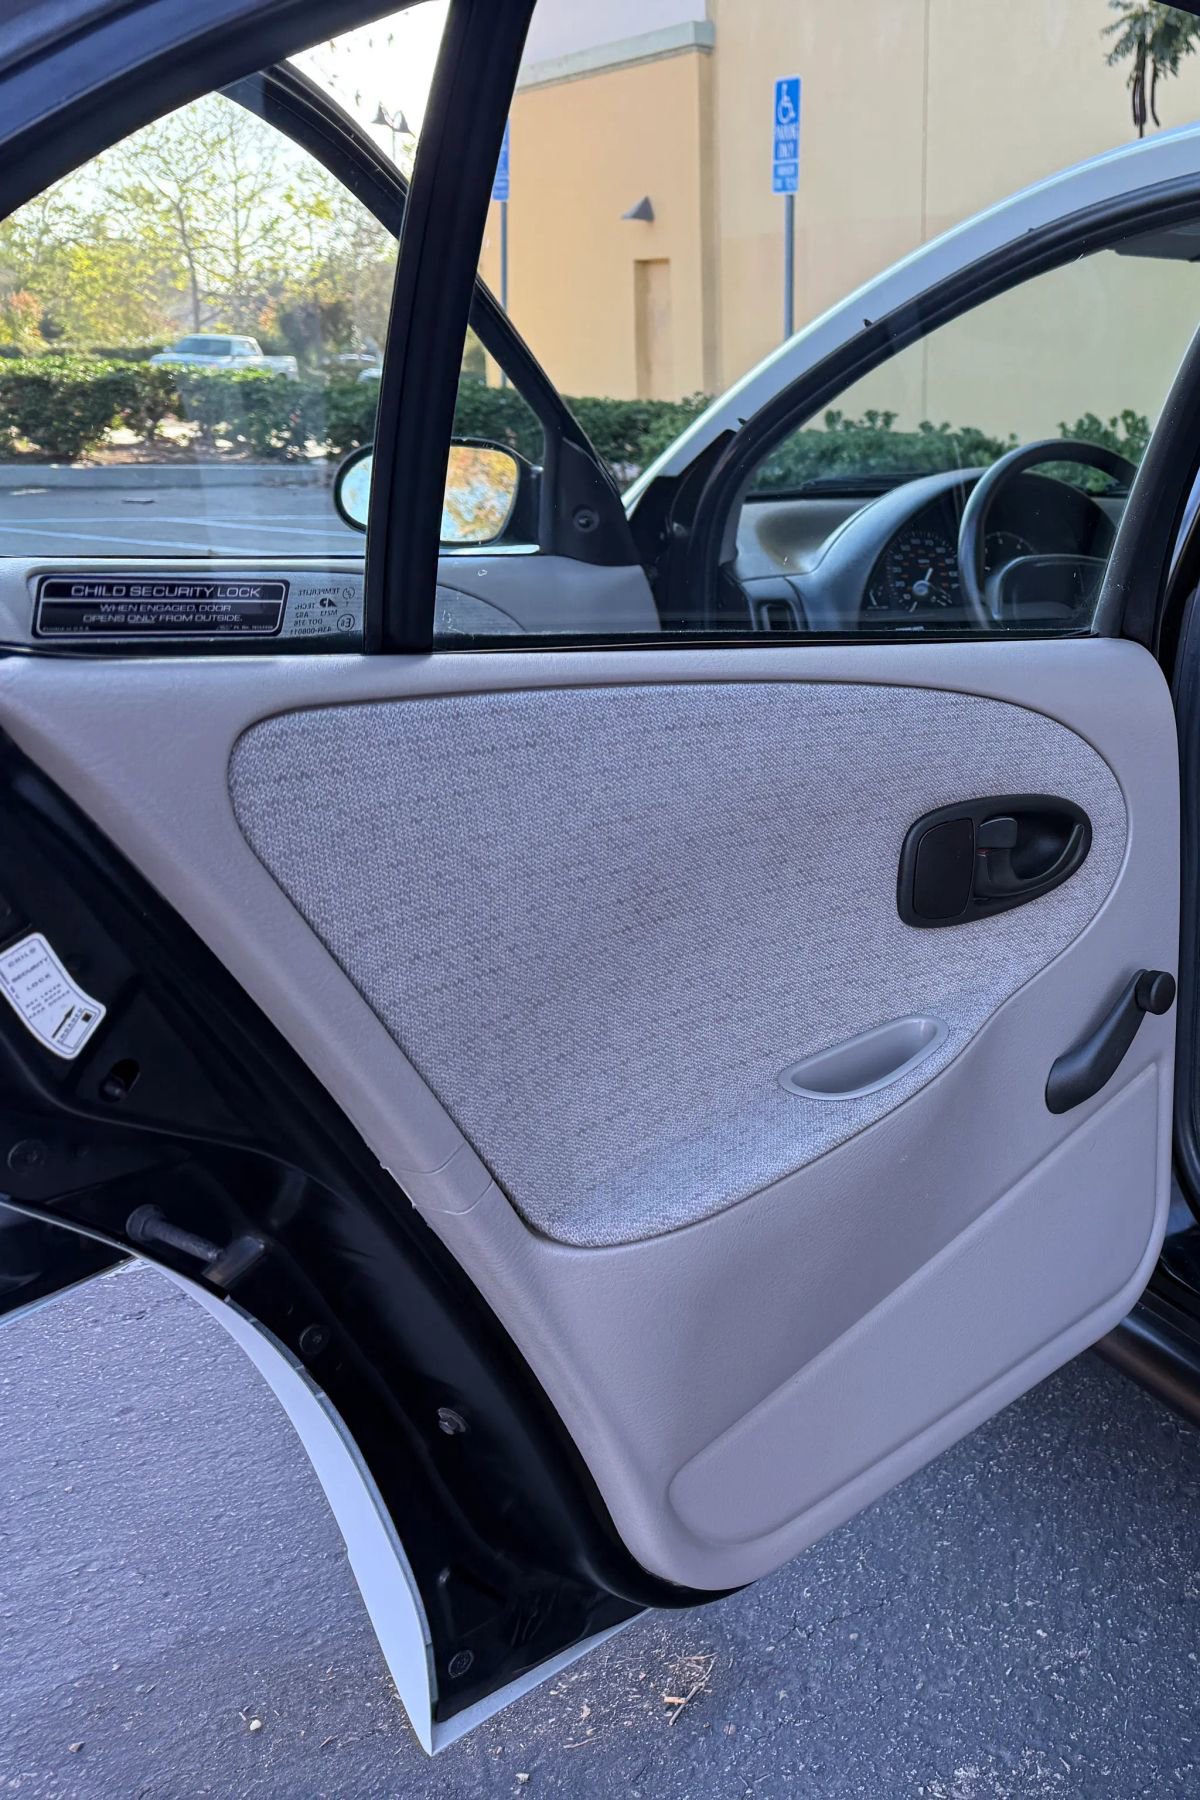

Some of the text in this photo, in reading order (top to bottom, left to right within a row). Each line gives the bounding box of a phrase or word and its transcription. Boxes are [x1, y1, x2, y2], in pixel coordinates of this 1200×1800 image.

[71, 585, 261, 598] CHILD SECURITY LOCK
[100, 604, 138, 612] WHEN
[83, 615, 125, 623] OPENS
[127, 614, 157, 623] ONLY
[159, 614, 193, 622] FROM
